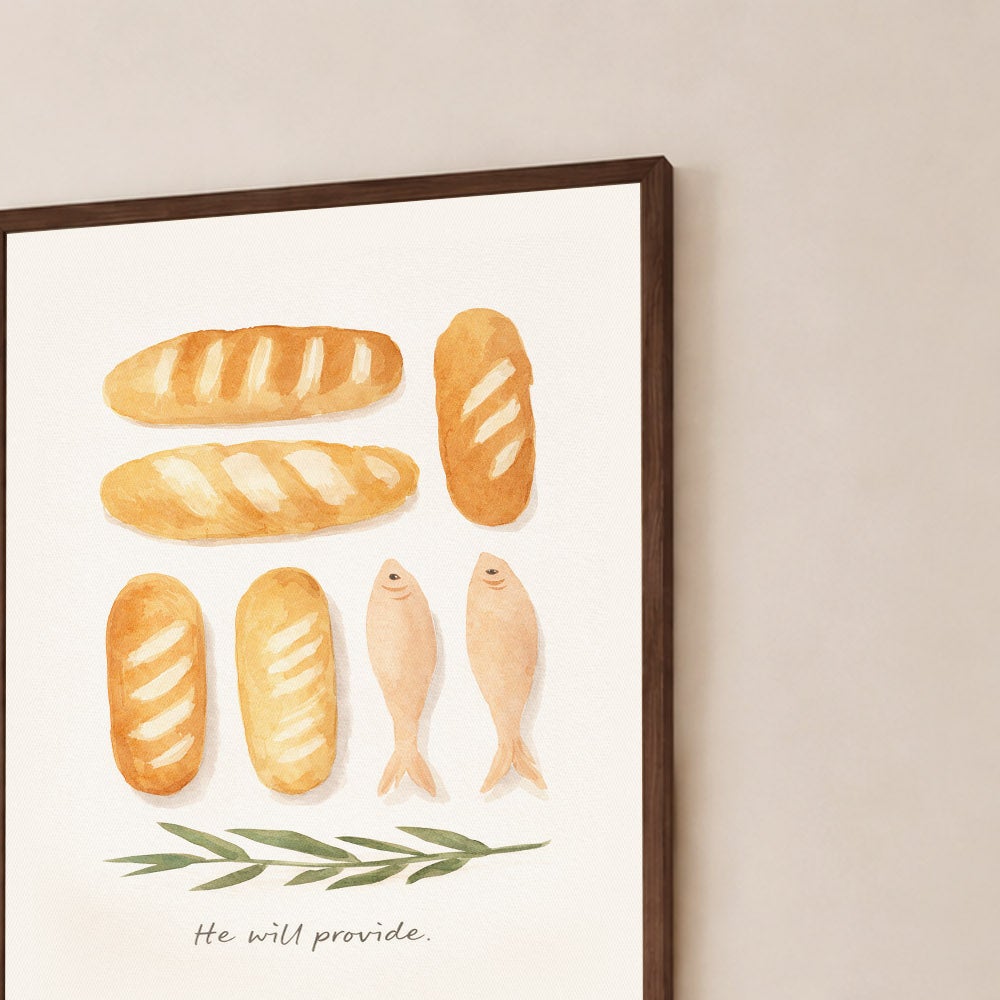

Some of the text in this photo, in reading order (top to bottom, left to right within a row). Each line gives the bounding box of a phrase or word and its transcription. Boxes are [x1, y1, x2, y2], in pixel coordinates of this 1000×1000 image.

[194, 921, 431, 952] He will provide.
